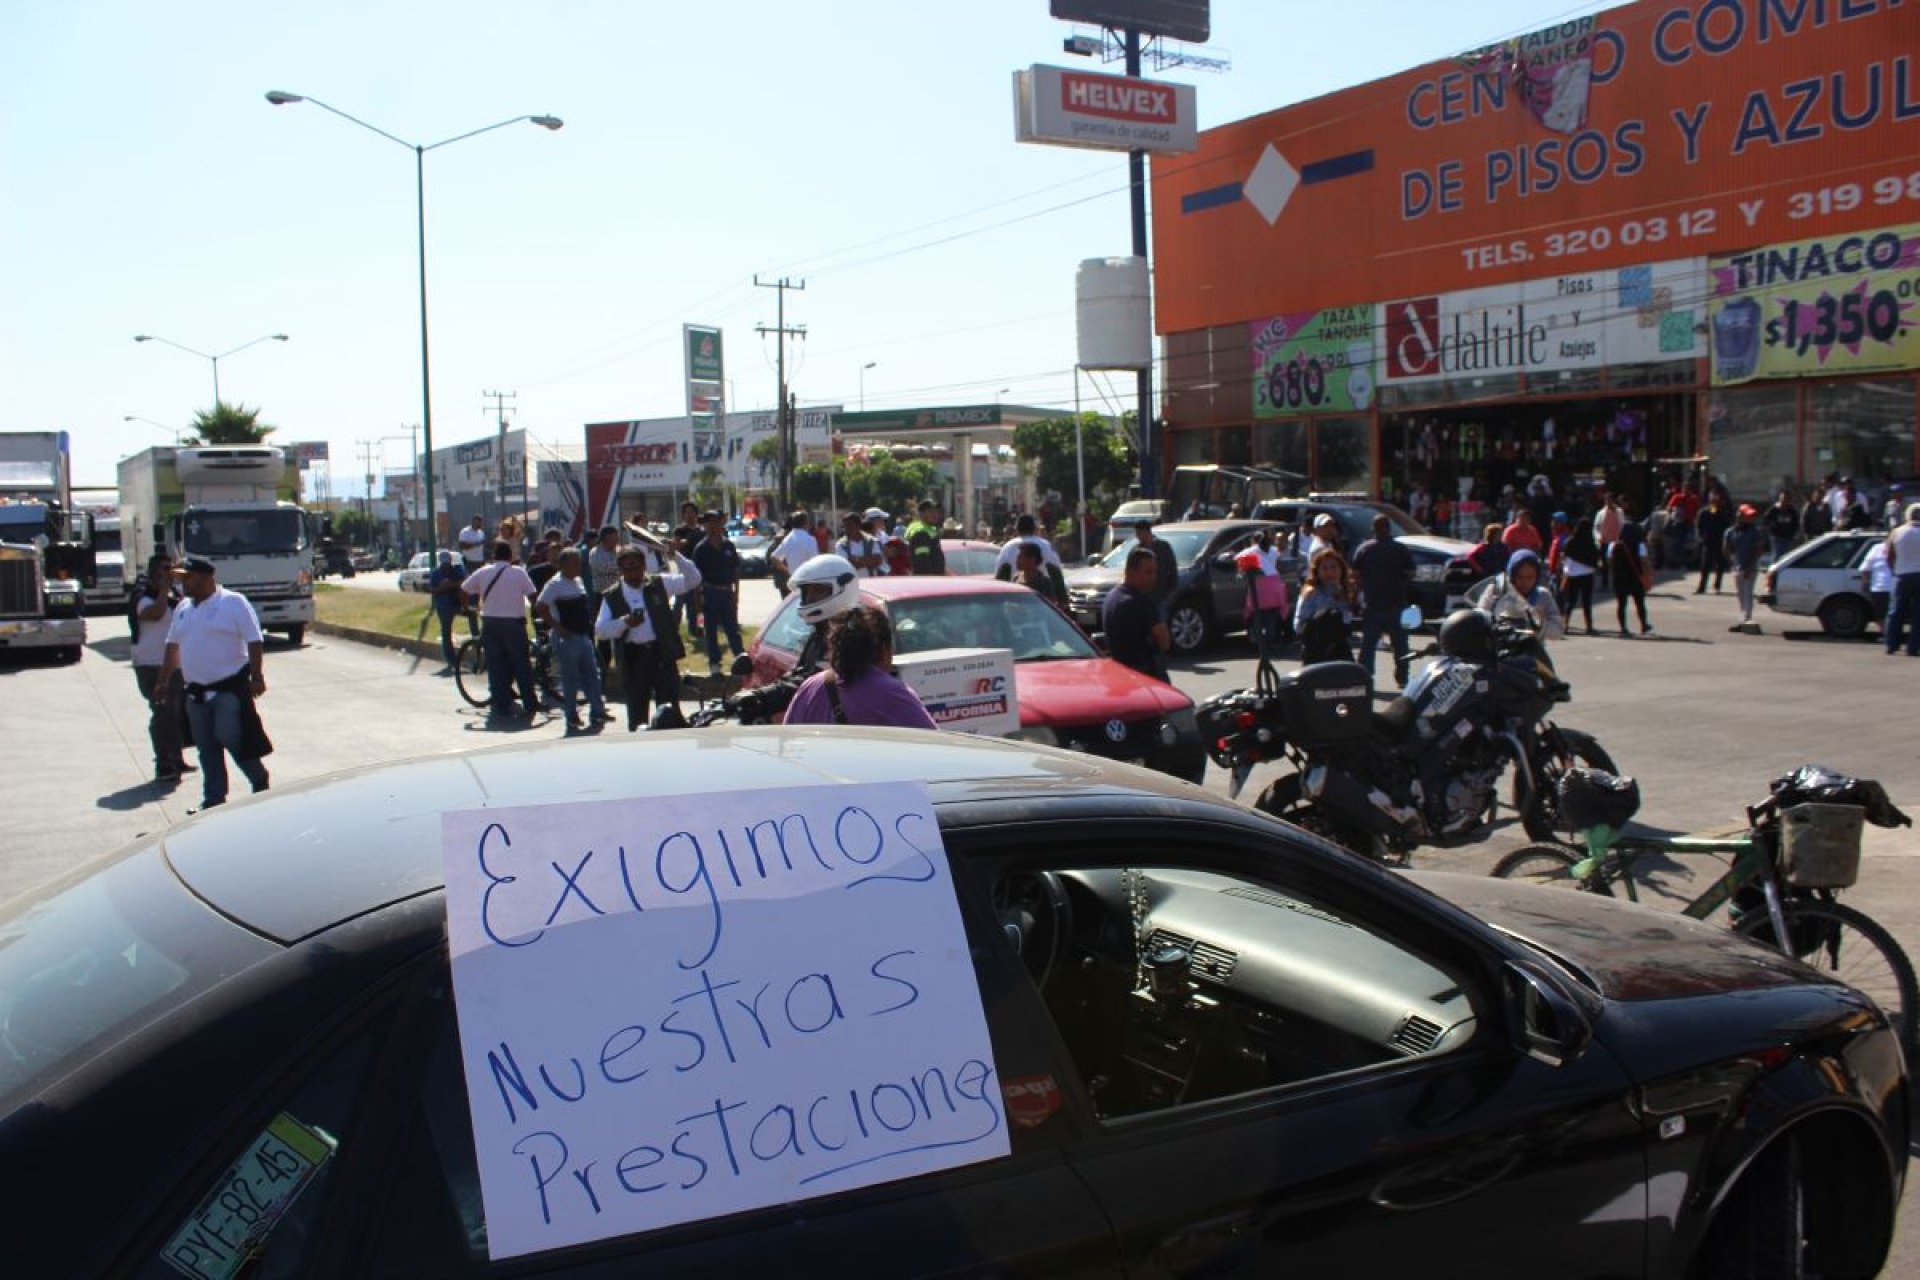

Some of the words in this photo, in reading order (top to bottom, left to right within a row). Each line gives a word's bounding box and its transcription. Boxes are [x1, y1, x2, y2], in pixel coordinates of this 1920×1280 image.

[1069, 79, 1168, 116] HELVEX
[1402, 160, 1464, 220] DE
[1485, 120, 1645, 204] PISOS
[1670, 102, 1711, 165] Y
[1462, 244, 1534, 272] TELS.
[1544, 228, 1611, 258] 320
[1620, 216, 1668, 245] 03
[1678, 208, 1717, 237] 12
[1739, 200, 1764, 226] Y
[1788, 183, 1861, 219] 319
[1557, 276, 1594, 296] Pisos
[1731, 232, 1901, 288] TINACO
[1322, 307, 1356, 326] TAZA
[1360, 305, 1370, 319] Y
[1441, 304, 1548, 372] daltile
[933, 407, 992, 424] PEMEX
[973, 677, 1005, 694] RC
[479, 804, 936, 970] Exigimos
[487, 949, 919, 1123] Nuestras
